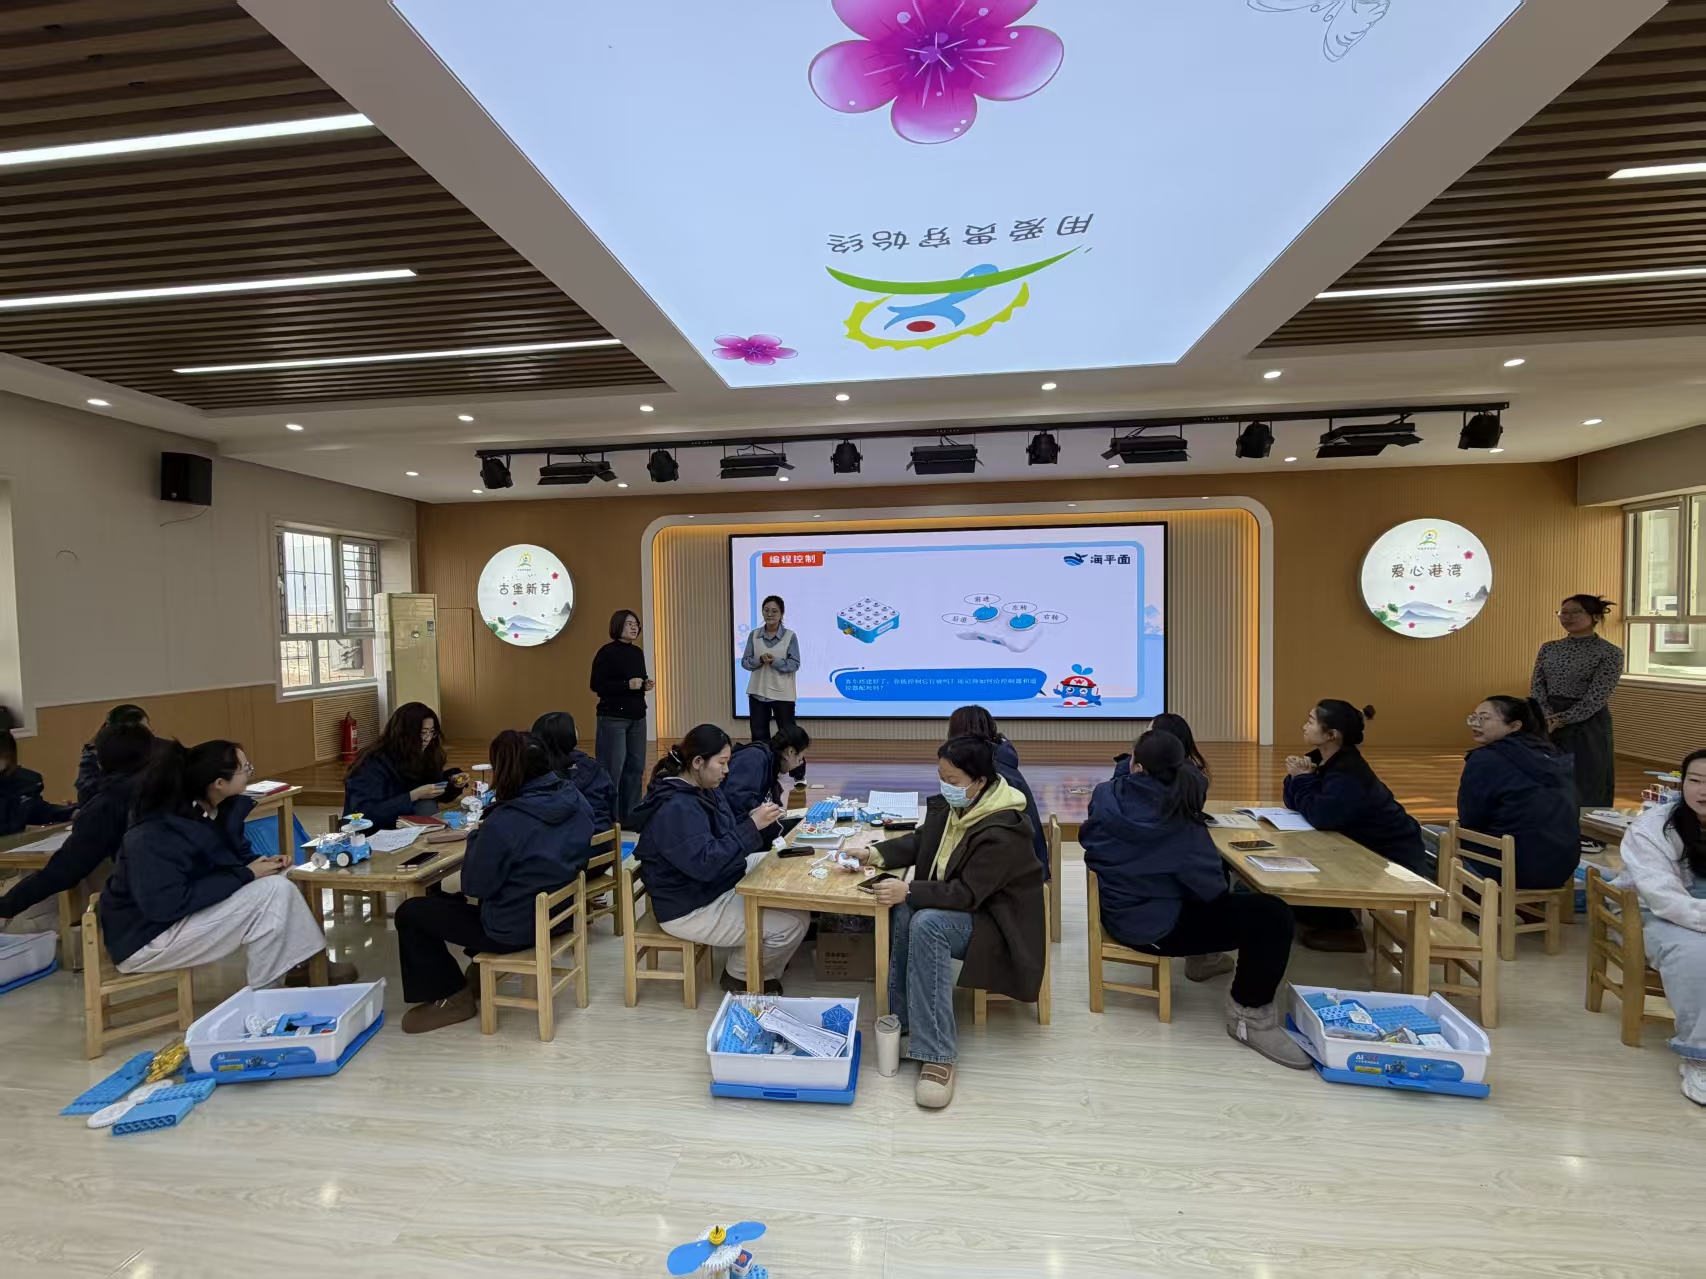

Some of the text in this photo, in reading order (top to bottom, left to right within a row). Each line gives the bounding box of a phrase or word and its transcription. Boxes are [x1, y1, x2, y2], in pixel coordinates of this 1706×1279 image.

[826, 213, 1094, 254] 用爱贯穿始终
[769, 554, 816, 564] 编程控制
[1090, 554, 1131, 565] 海平面
[1391, 563, 1463, 578] 爱心港湾
[499, 582, 551, 595] 古堡新芽
[1043, 613, 1059, 621] 右转
